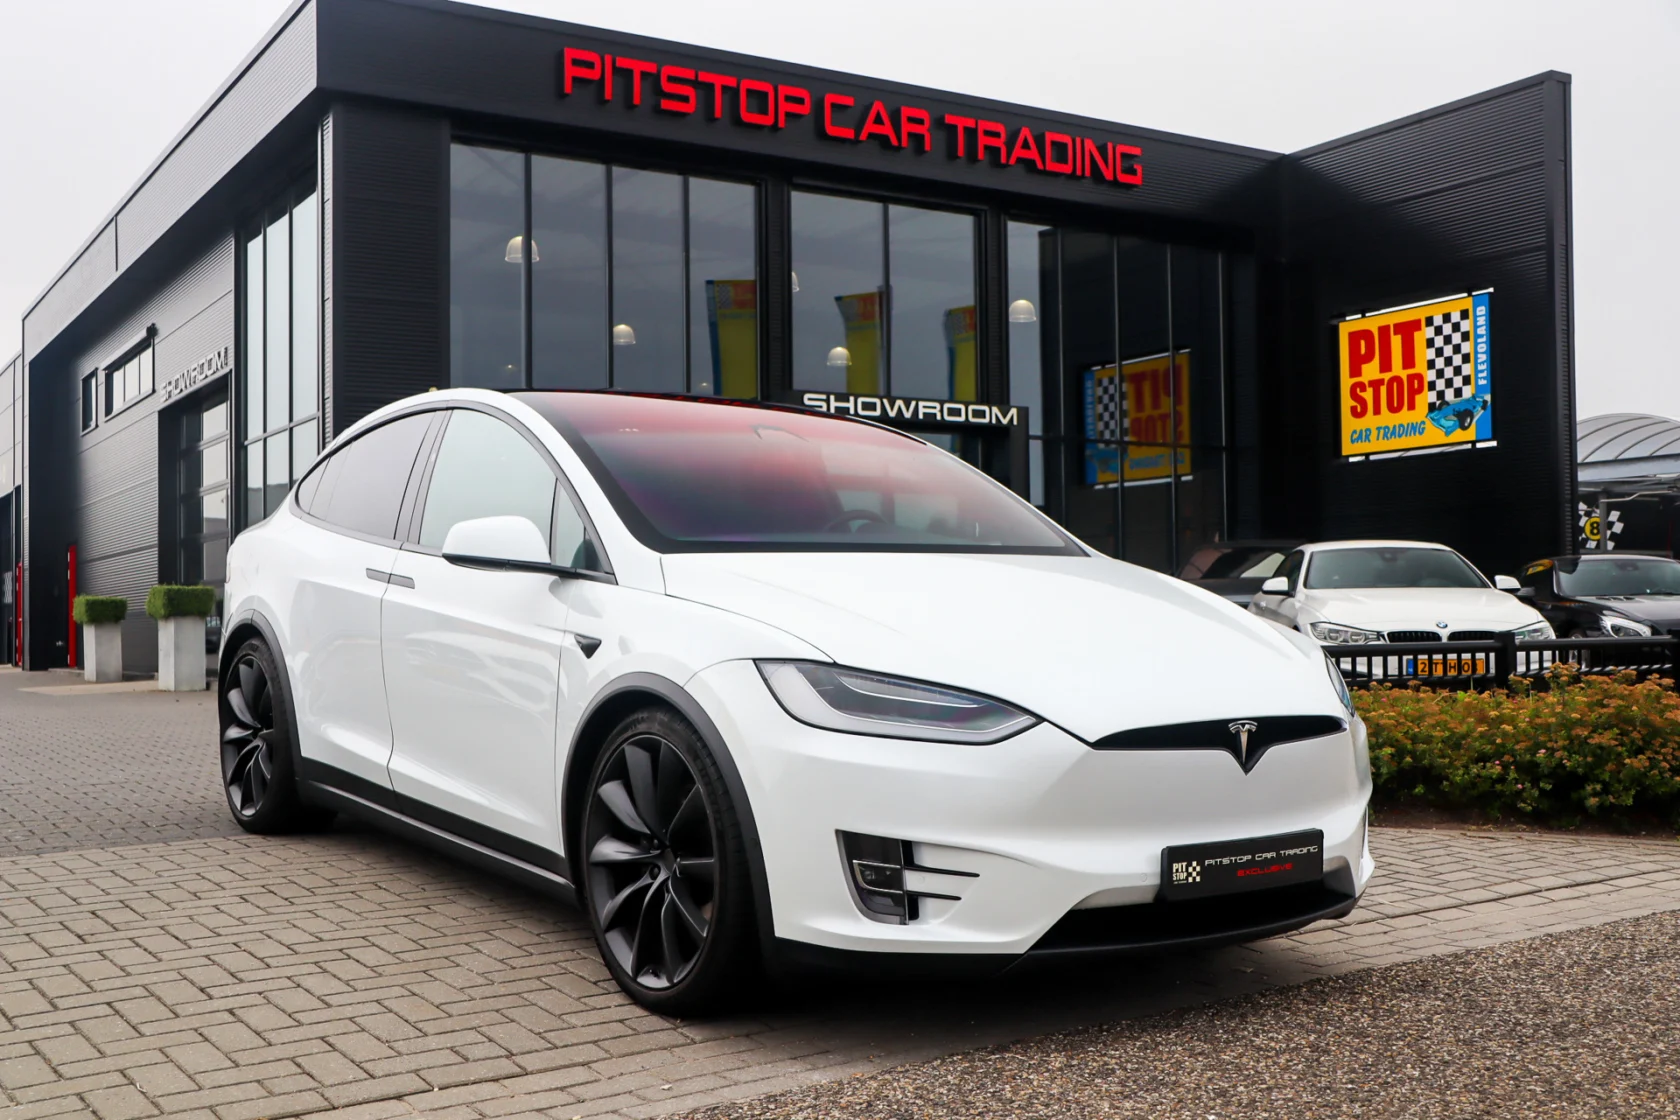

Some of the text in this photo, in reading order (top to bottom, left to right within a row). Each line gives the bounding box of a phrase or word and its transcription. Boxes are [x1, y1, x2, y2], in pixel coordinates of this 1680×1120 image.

[562, 47, 1143, 186] PITSTOP CAR TRADING
[1347, 318, 1422, 379] PIT
[1476, 305, 1488, 386] FLEVOLAND
[1349, 372, 1425, 420] STOP
[802, 392, 1018, 426] SHOWROOM
[1350, 420, 1427, 445] CAR TRADING
[1589, 520, 1600, 536] 8
[1172, 862, 1188, 873] PIT
[1204, 845, 1318, 867] PITSTOP CAR TRADING
[1172, 872, 1188, 881] STOP
[1237, 863, 1293, 877] EXCLUSIVE
